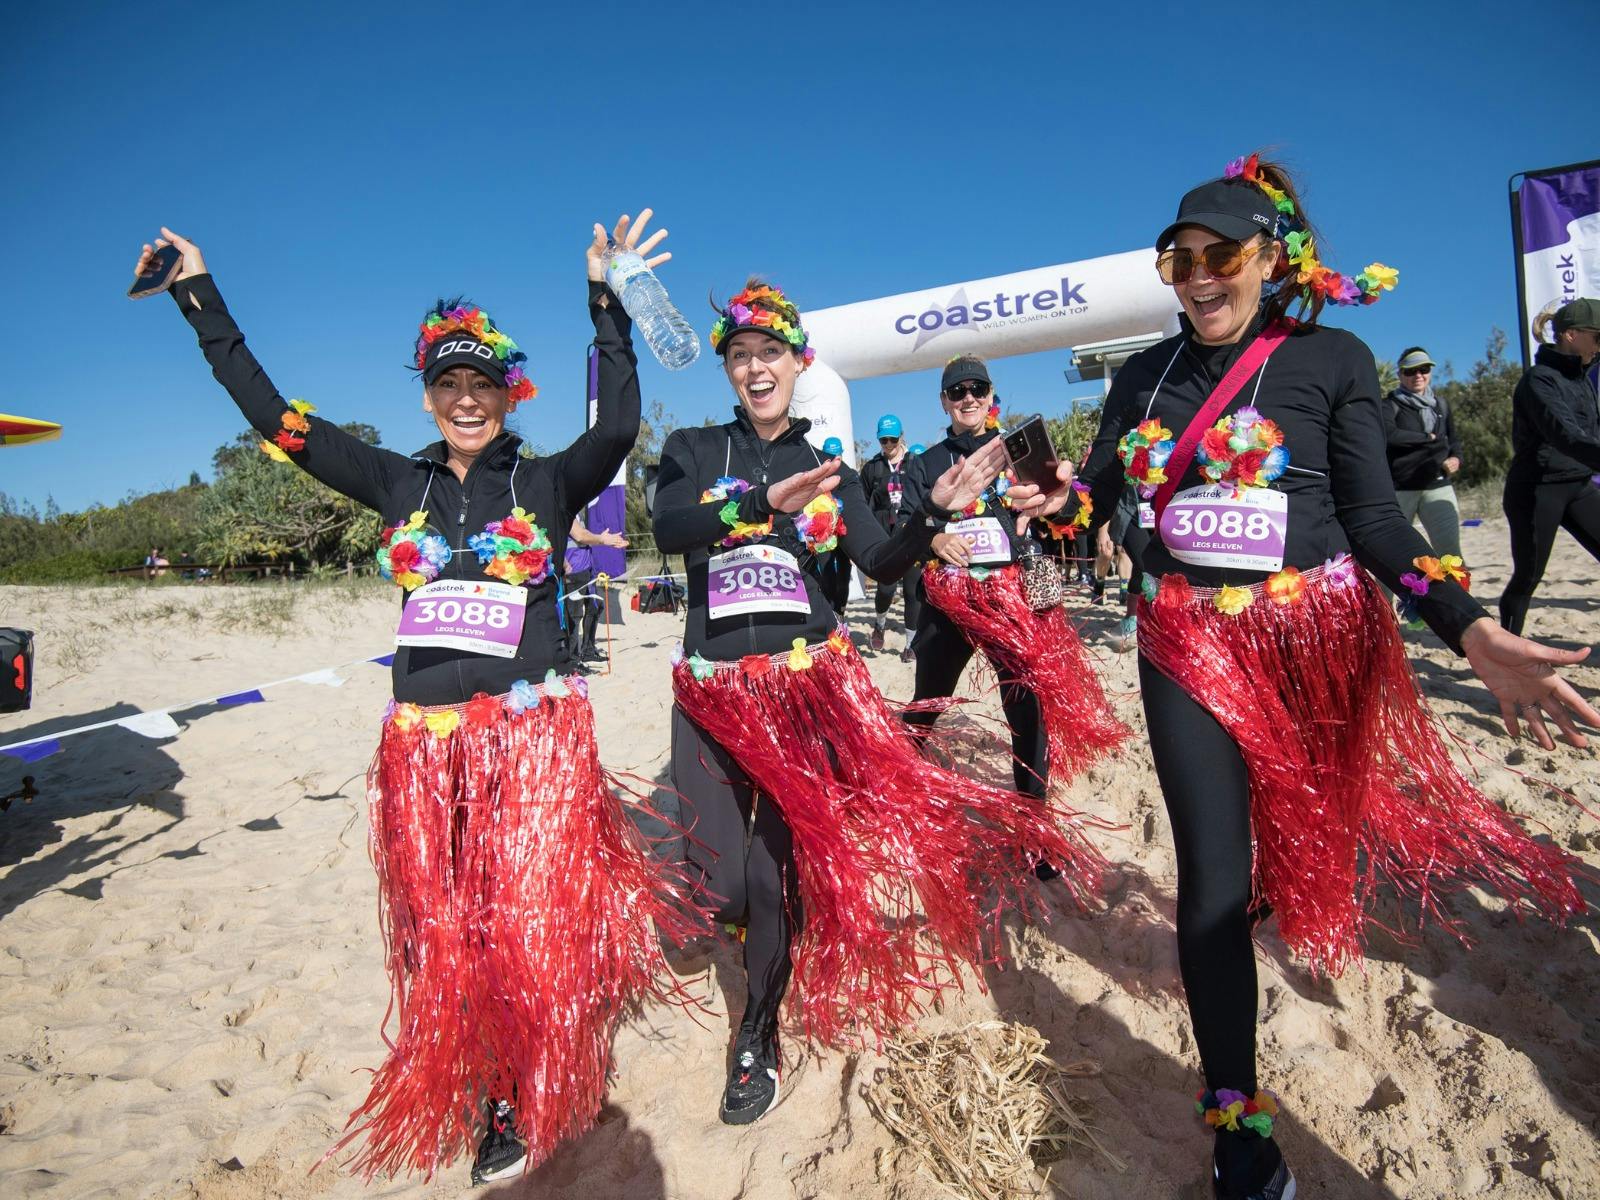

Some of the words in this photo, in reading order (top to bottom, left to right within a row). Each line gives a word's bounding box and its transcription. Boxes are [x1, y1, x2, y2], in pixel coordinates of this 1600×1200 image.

[895, 277, 1088, 335] coastrek
[983, 320, 1006, 330] WILD
[1009, 314, 1048, 327] WOMEN
[1051, 309, 1067, 318] ON
[1070, 305, 1089, 315] TOP
[1171, 509, 1271, 541] 3088
[1192, 541, 1211, 549] LEGS
[1212, 542, 1243, 551] ELEVEN
[425, 584, 465, 593] coastrek
[719, 566, 797, 594] 3088
[739, 591, 756, 600] LEGS
[413, 600, 510, 629] 3088
[434, 625, 454, 633] LEGS
[455, 627, 486, 637] ELEVEN
